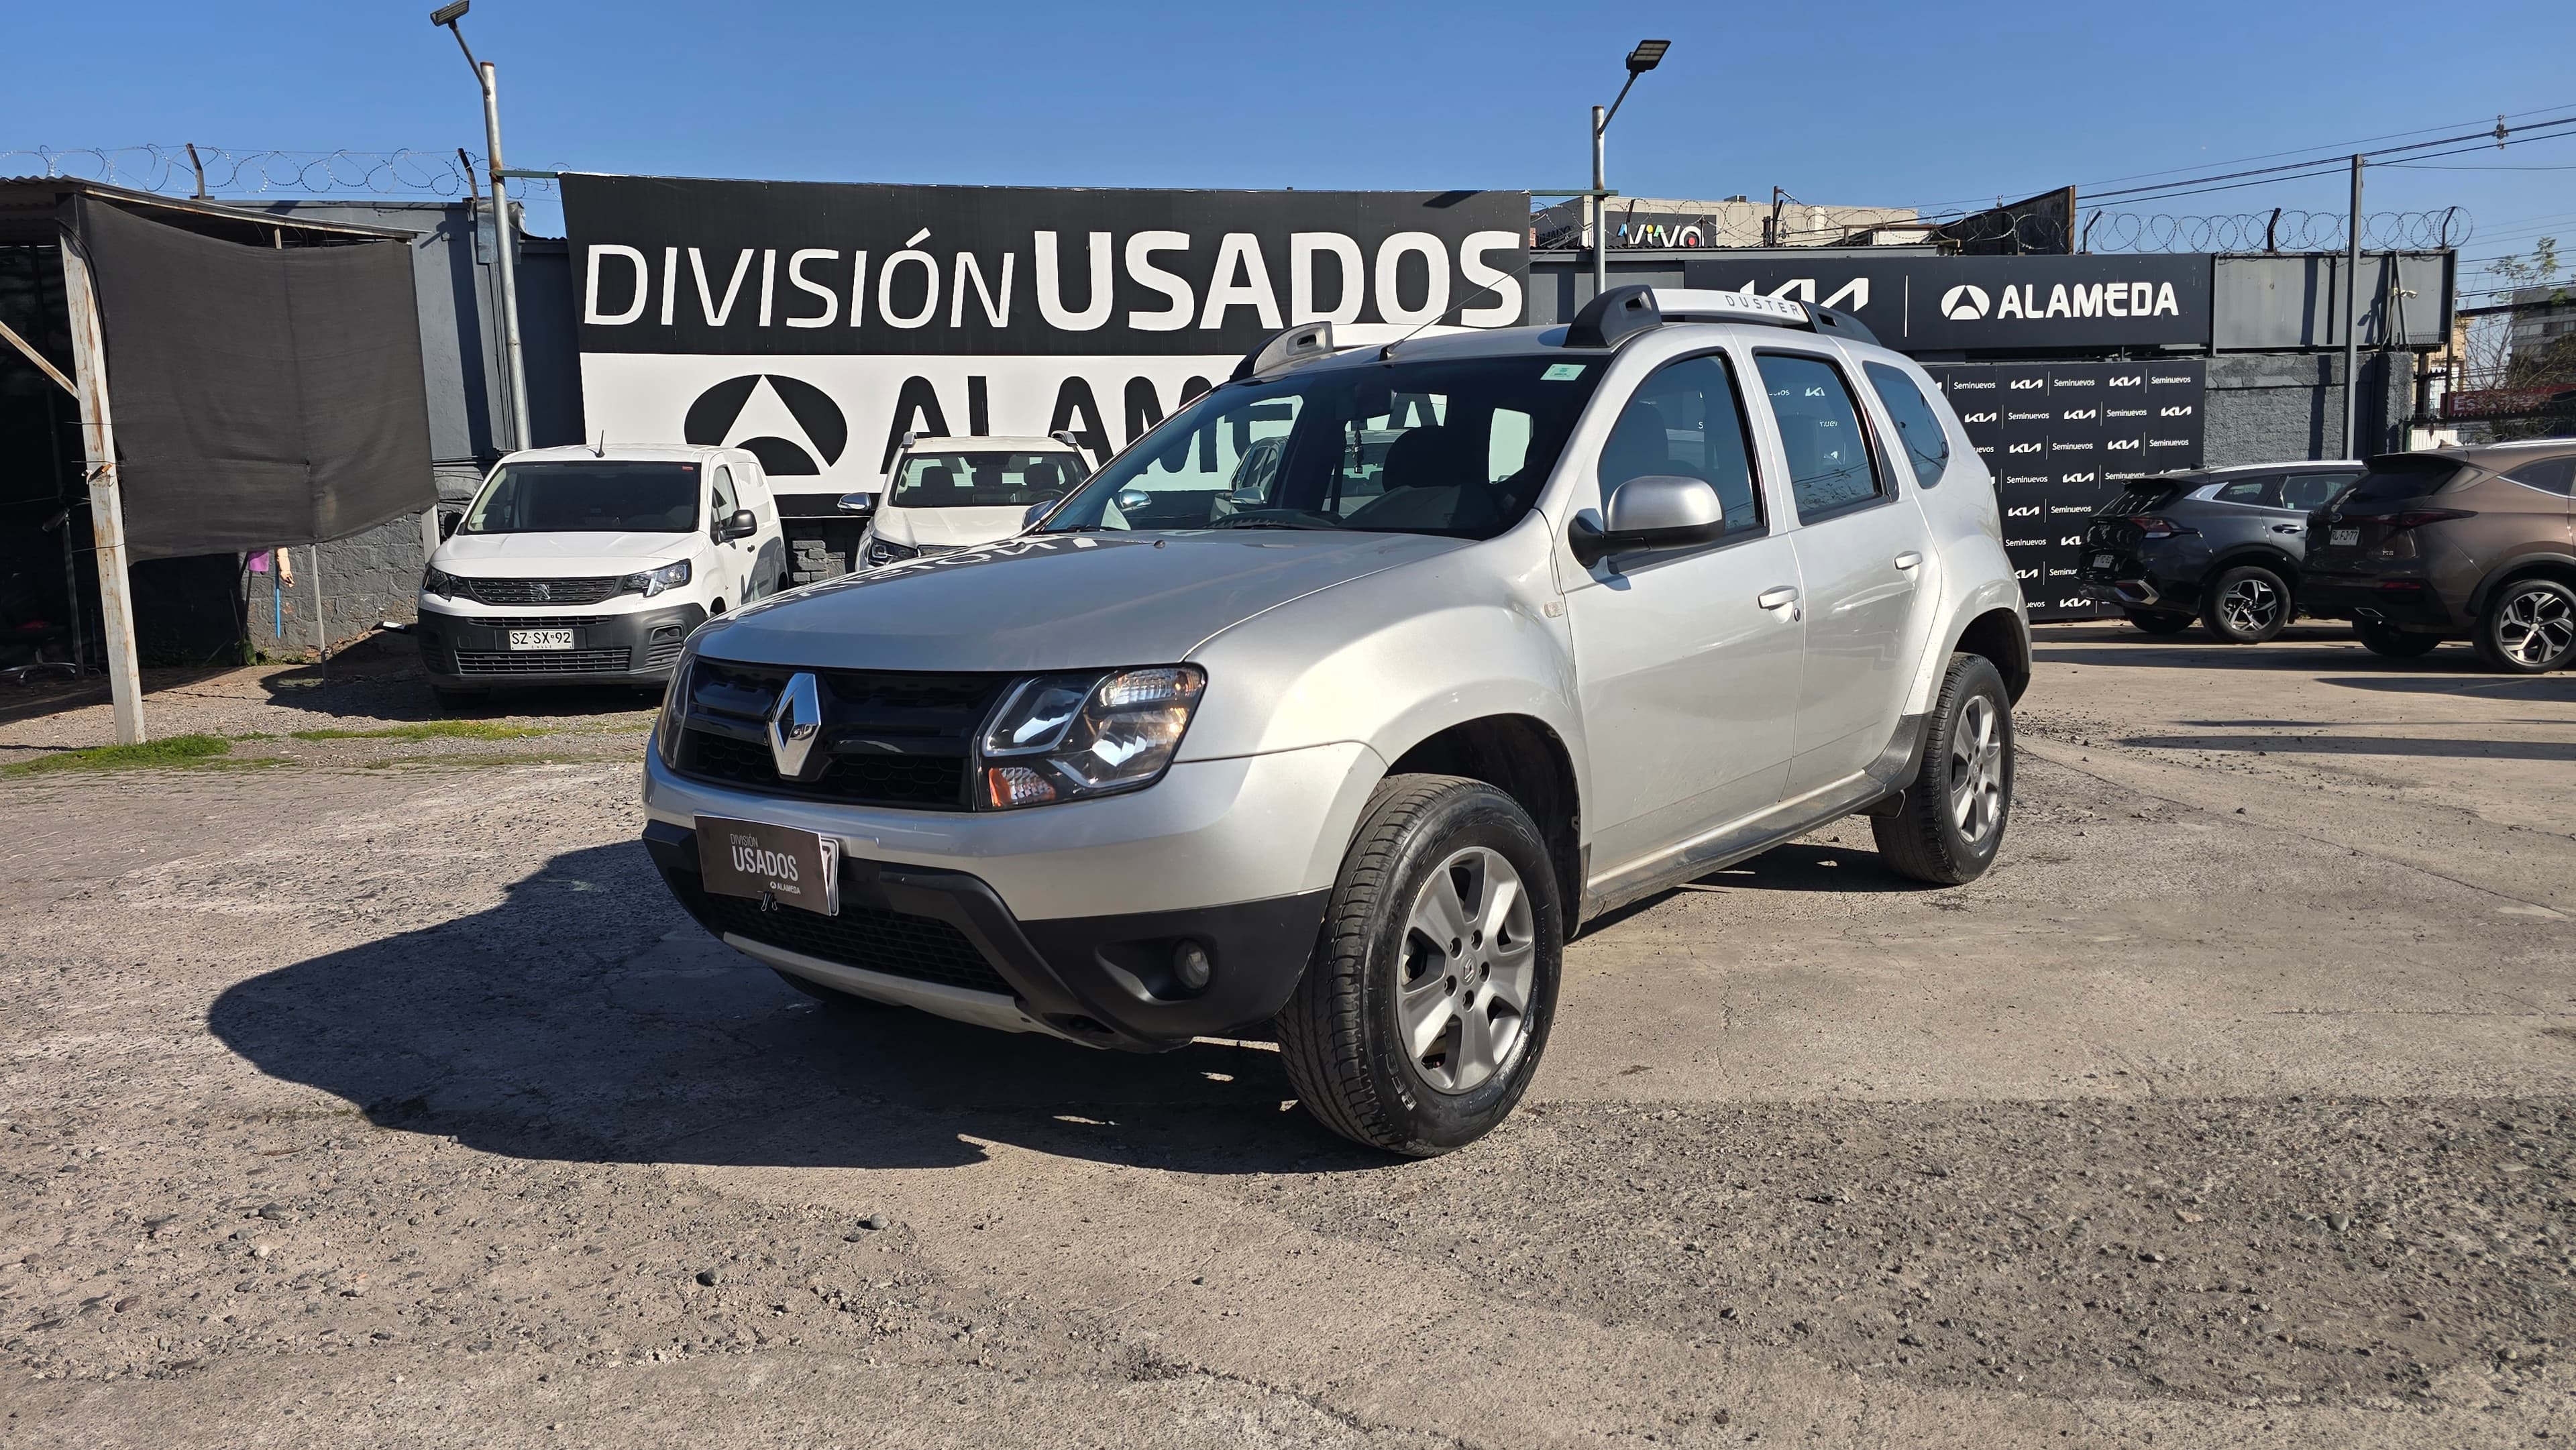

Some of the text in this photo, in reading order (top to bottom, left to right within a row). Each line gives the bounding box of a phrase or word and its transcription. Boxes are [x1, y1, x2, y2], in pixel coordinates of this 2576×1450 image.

[584, 227, 1522, 331] DIVISIÓN USADOS
[1725, 295, 1801, 316] DUSTER
[1997, 282, 2180, 319] ALAMEDA
[730, 833, 758, 848] DIVISIÓN
[732, 846, 799, 882] USADOS
[777, 882, 801, 895] ALAMEDA
